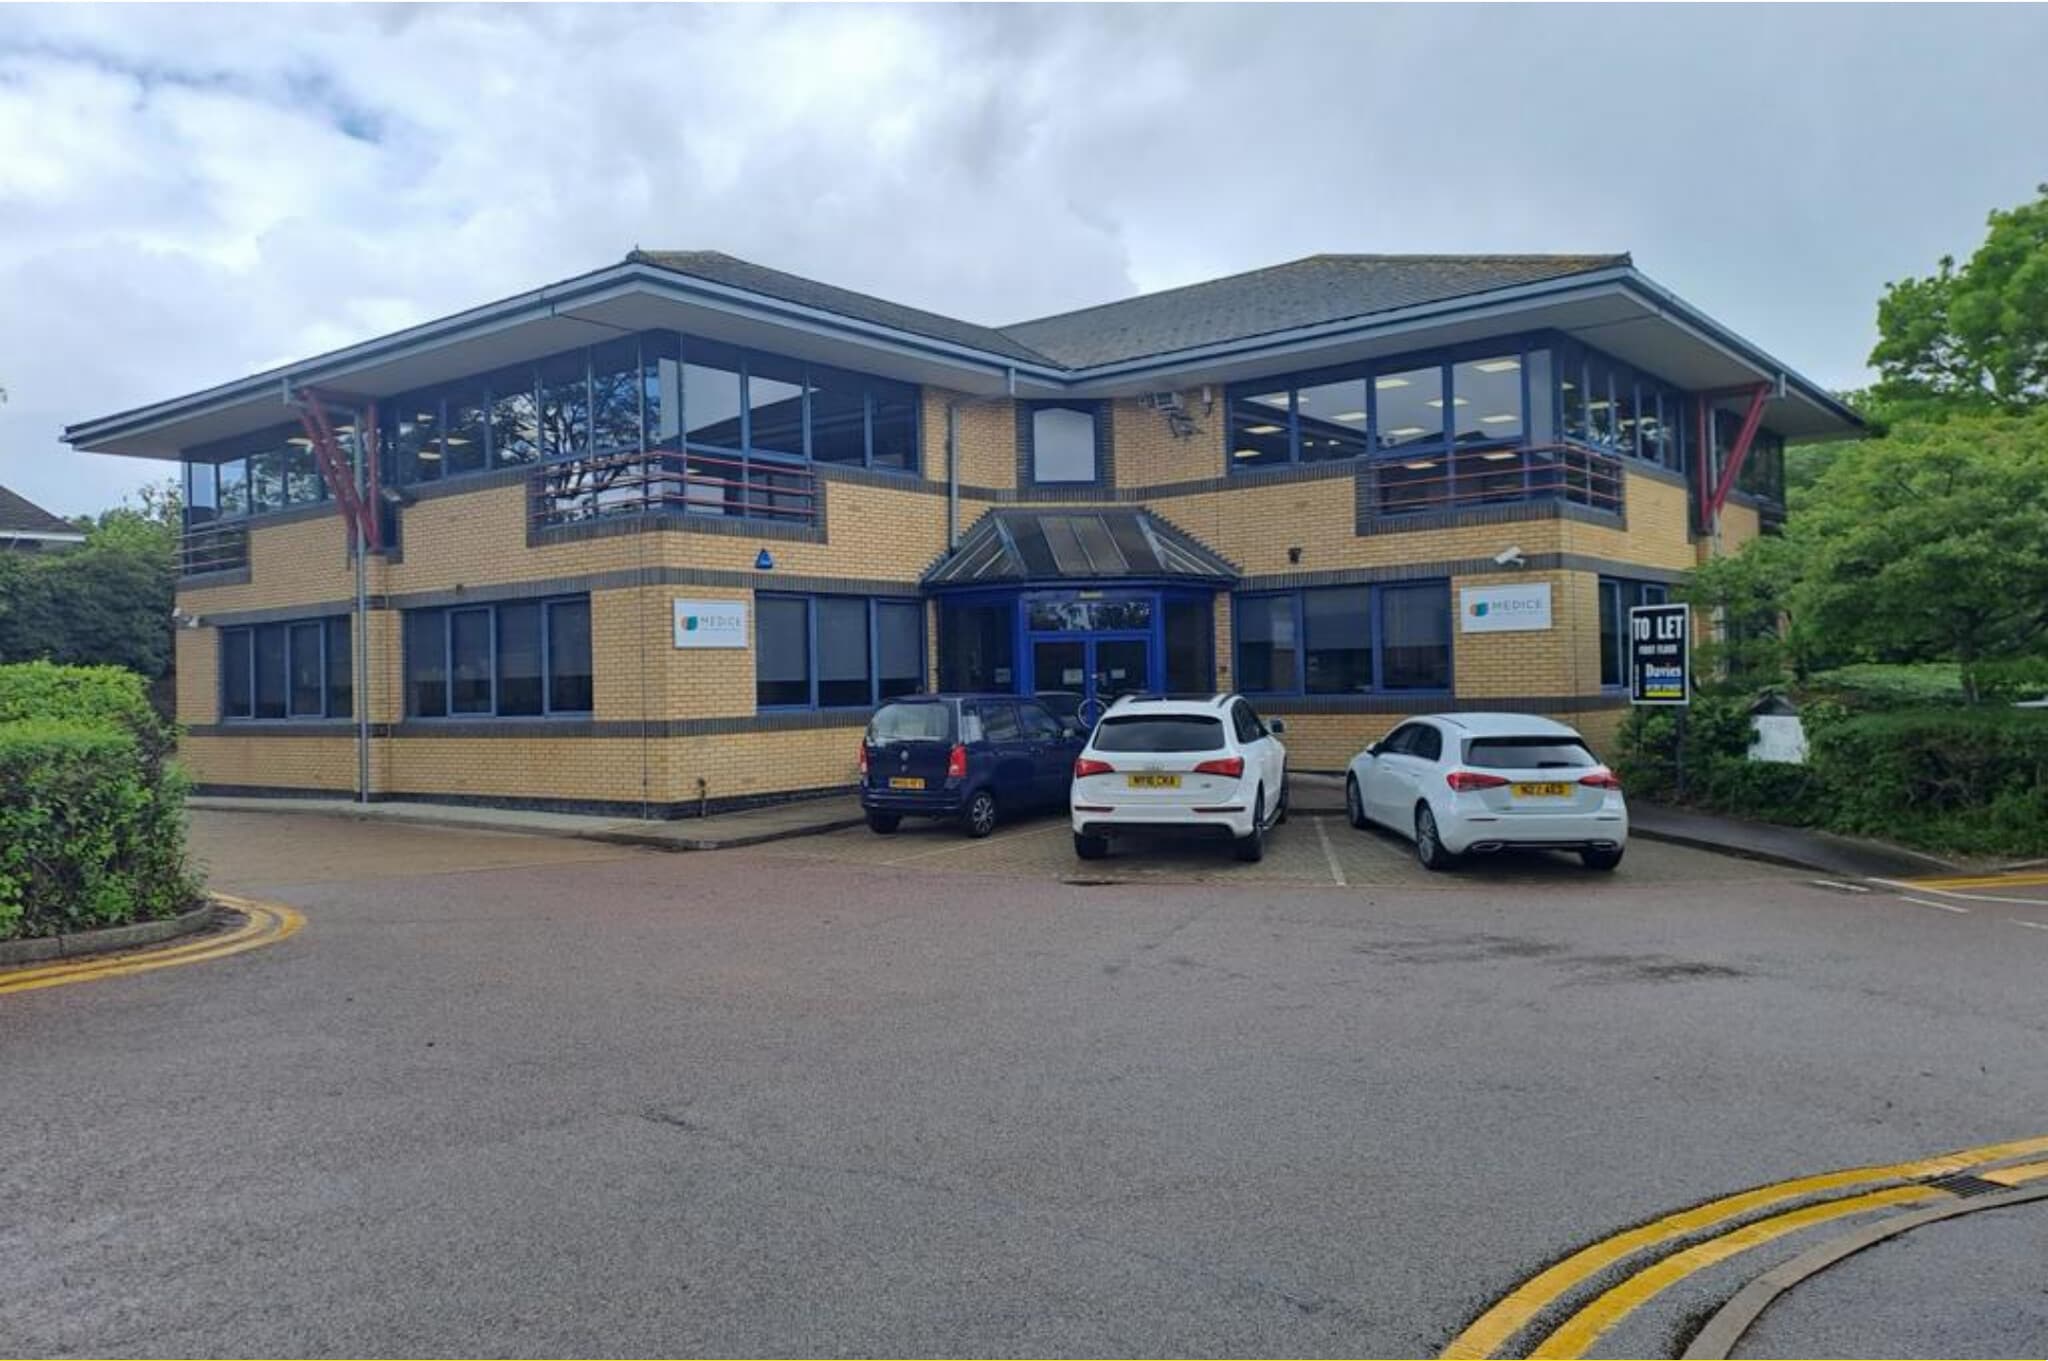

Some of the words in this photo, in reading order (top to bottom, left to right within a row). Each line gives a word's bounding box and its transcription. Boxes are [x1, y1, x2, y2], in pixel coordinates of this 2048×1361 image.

[1492, 598, 1543, 610] MEDICE
[700, 615, 741, 627] MEDICE
[1633, 617, 1650, 640] TO
[1657, 615, 1684, 639] LET
